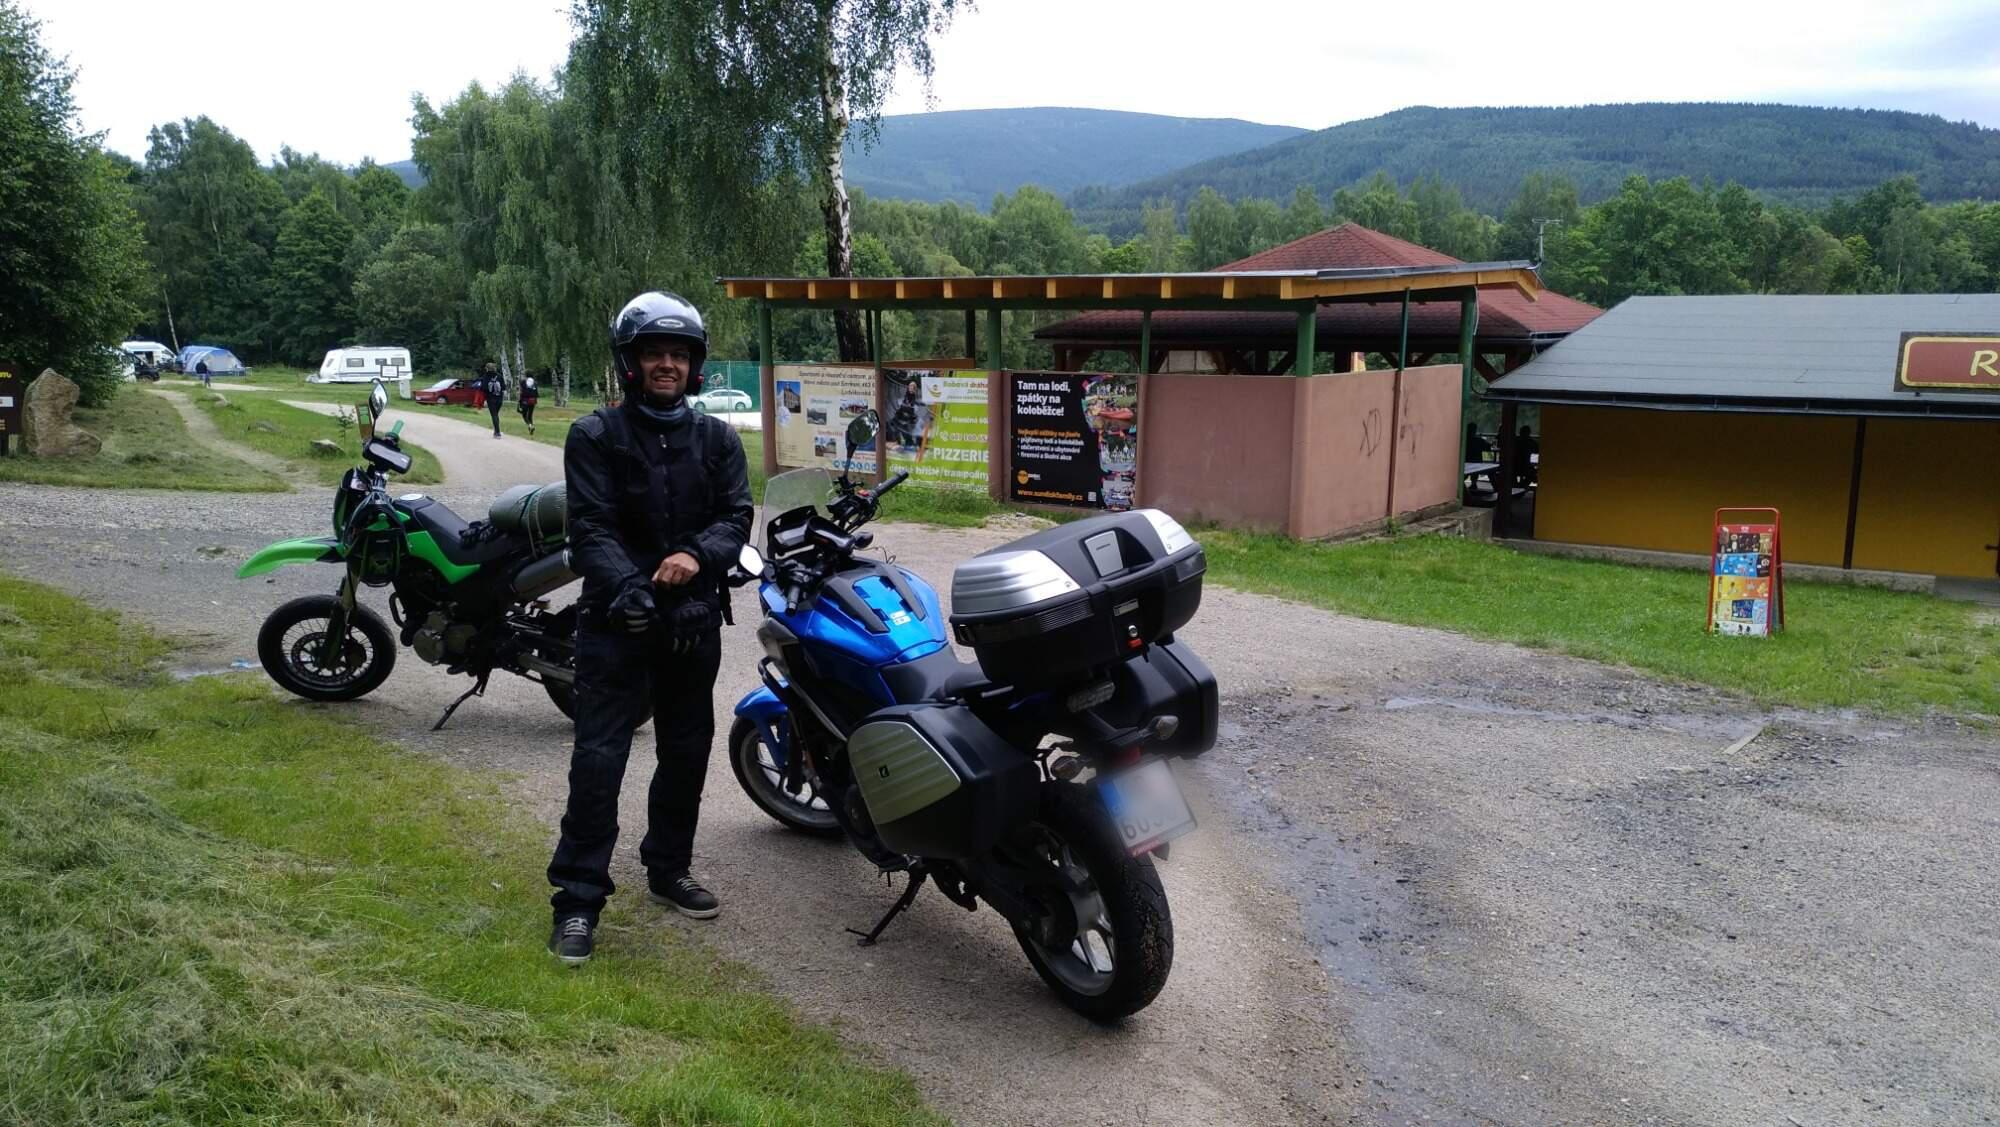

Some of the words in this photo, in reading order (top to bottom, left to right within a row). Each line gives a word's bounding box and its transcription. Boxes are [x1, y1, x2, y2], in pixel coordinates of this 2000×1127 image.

[1017, 381, 1037, 390] Tam
[1038, 383, 1050, 391] na
[1017, 393, 1048, 405] zpátky
[1049, 395, 1061, 404] na
[1017, 404, 1064, 416] koloběžce!
[933, 447, 989, 463] PIZZERIE
